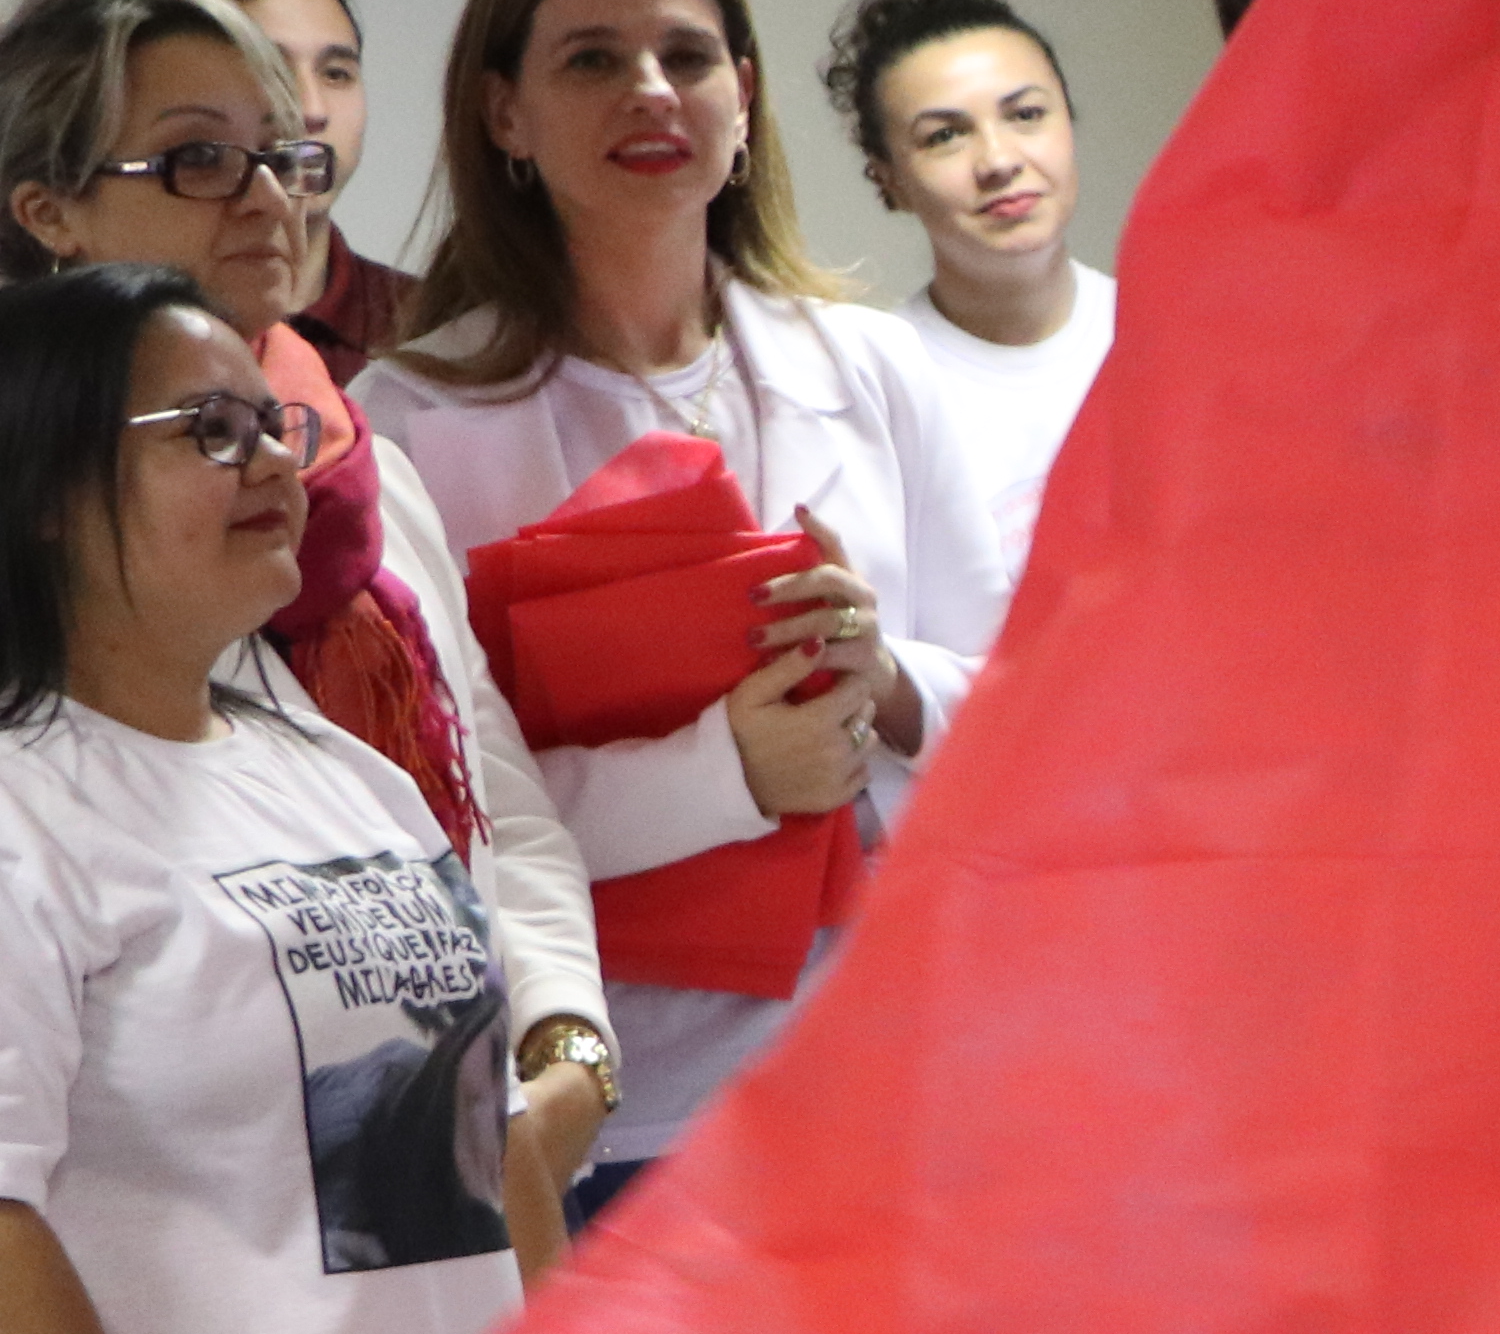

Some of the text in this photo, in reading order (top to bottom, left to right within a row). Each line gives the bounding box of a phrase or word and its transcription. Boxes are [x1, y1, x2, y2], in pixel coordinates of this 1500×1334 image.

[287, 937, 364, 974] DEUS
[371, 931, 428, 961] QUE
[333, 961, 474, 1011] MILAGRES
